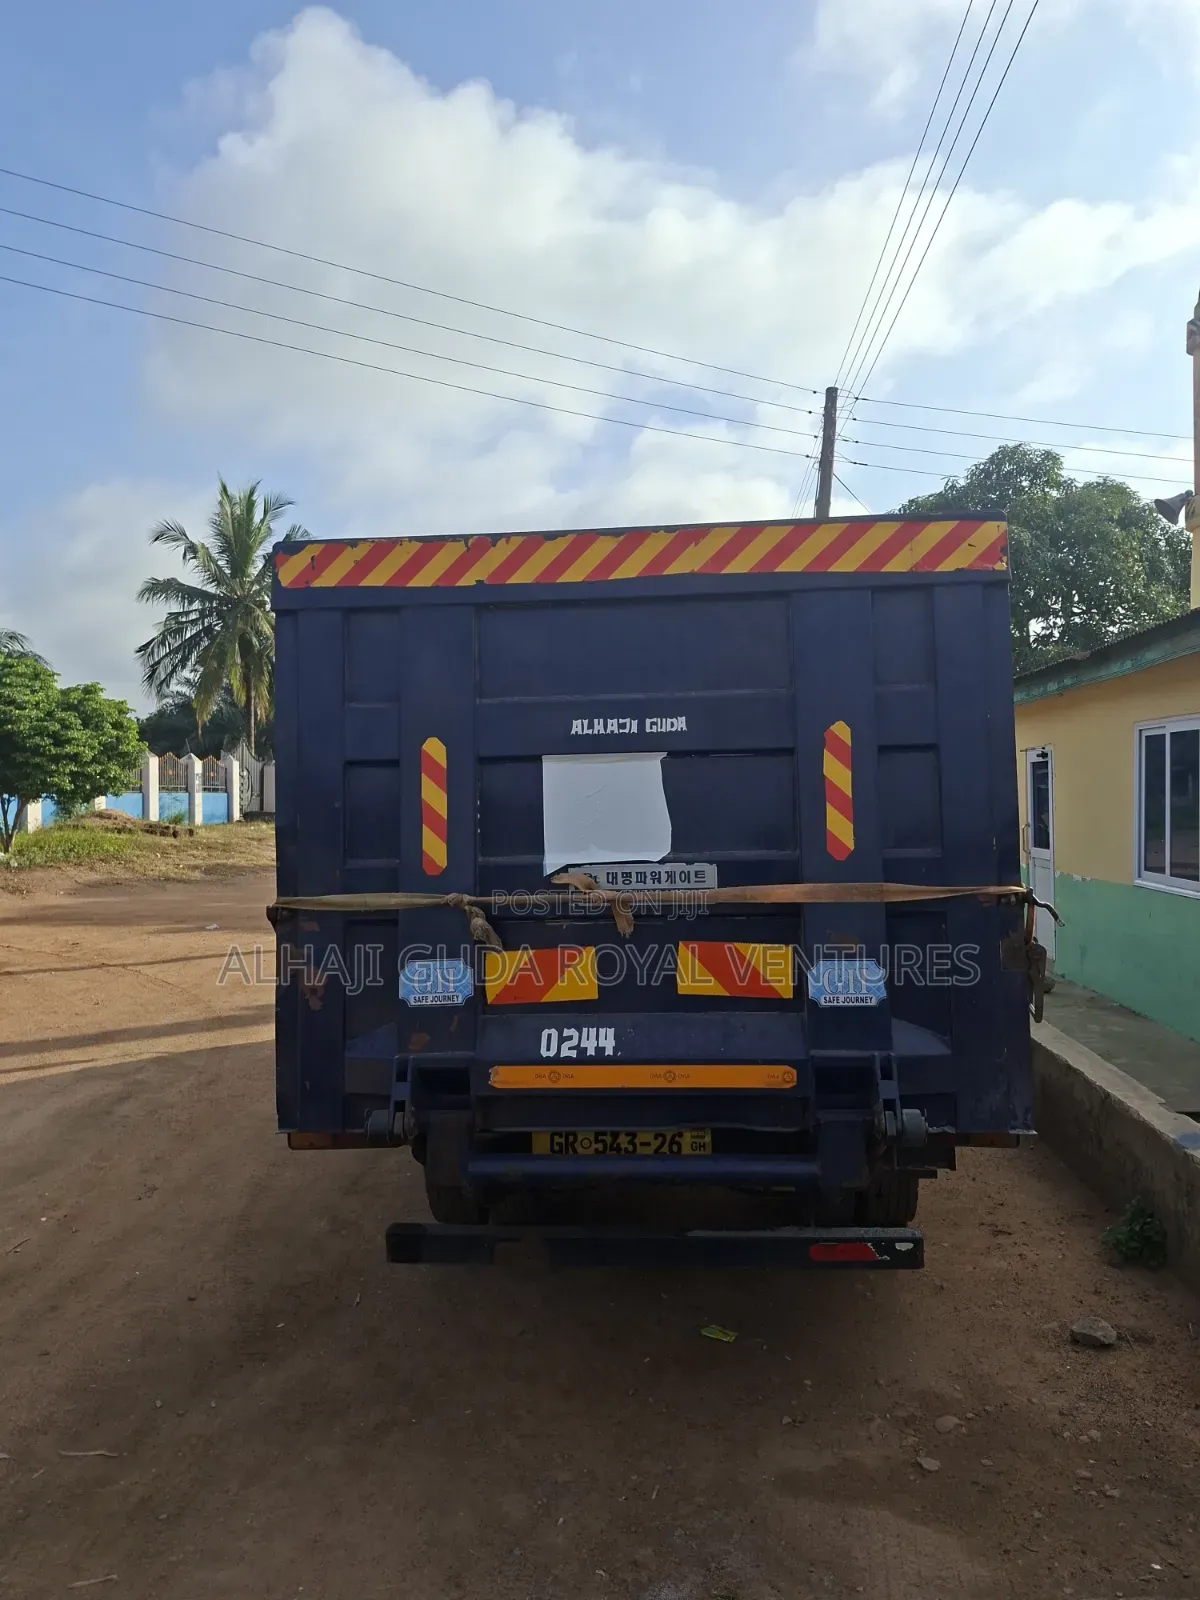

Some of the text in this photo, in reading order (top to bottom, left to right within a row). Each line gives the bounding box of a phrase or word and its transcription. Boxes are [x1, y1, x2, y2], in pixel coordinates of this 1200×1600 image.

[570, 716, 688, 735] ALHAJI GUDA
[606, 870, 707, 886] 대명파워게이트
[413, 994, 460, 1004] SAFE JOURNEY
[823, 996, 874, 1004] SAFE JOURNEY
[539, 1027, 616, 1058] 0244
[690, 1141, 706, 1152] GH
